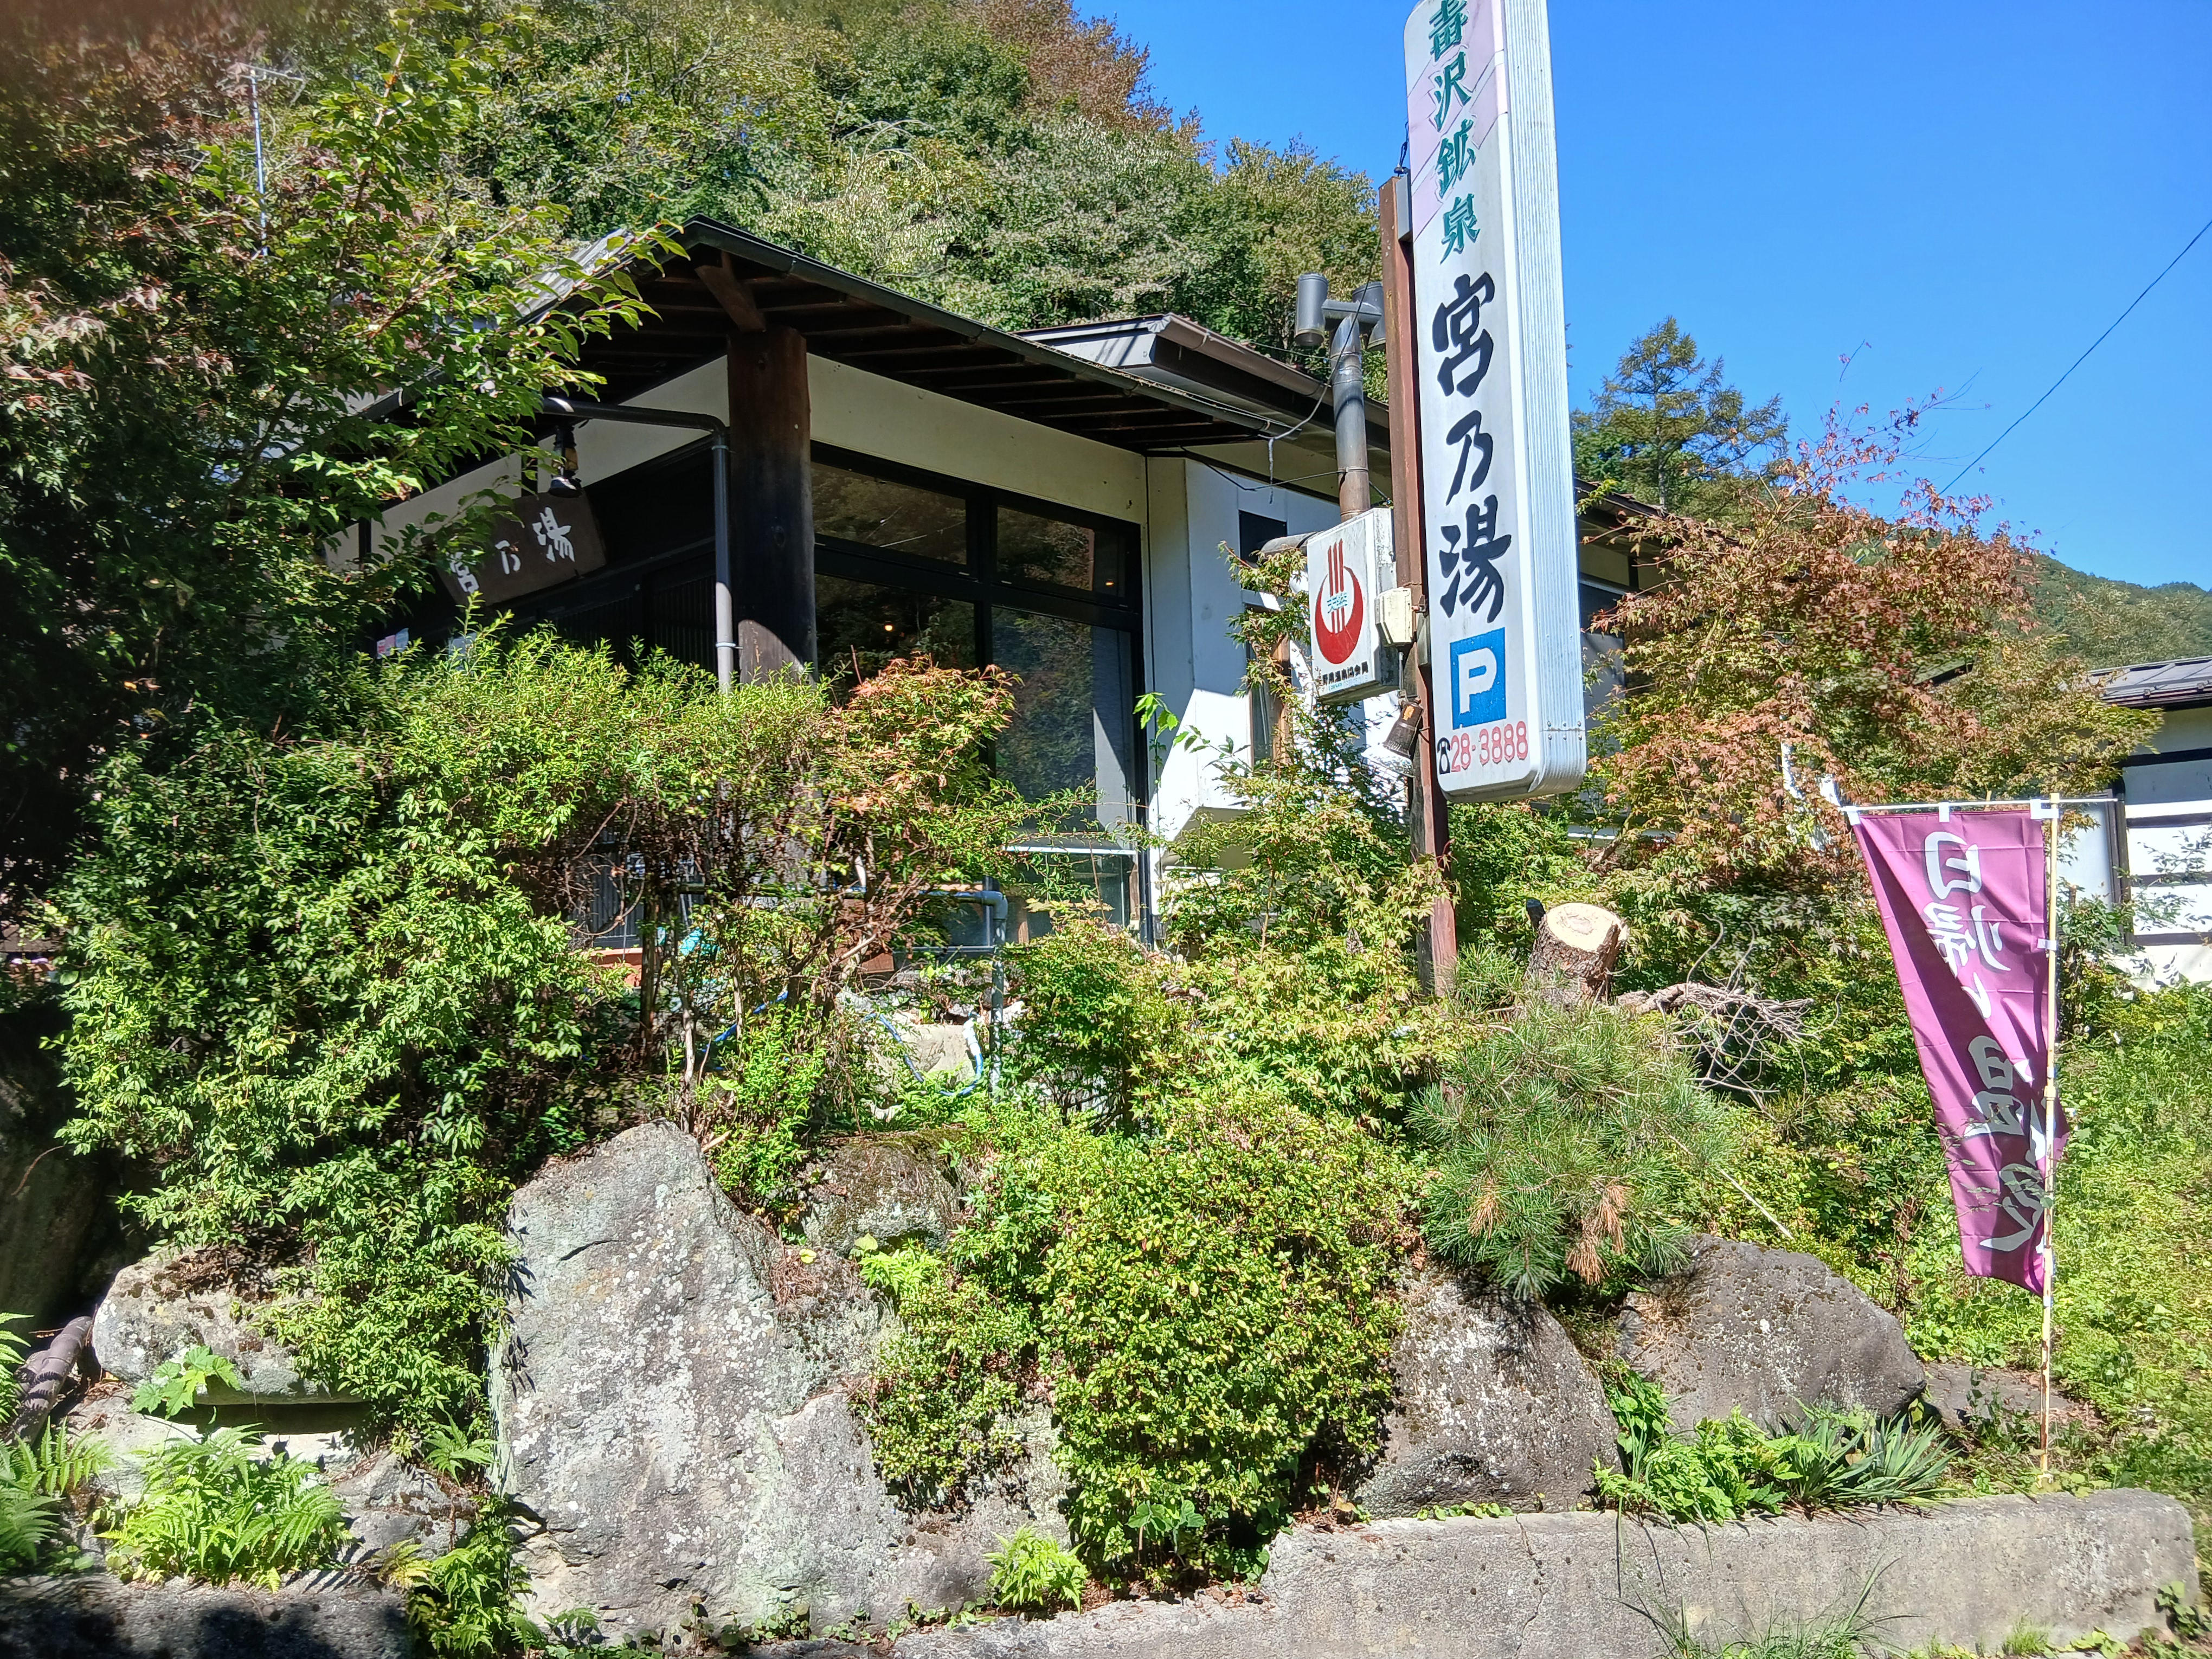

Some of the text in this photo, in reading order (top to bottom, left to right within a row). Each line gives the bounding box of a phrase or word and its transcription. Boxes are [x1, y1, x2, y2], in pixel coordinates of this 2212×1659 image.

[1428, 0, 1480, 263] 毒沢鉱泉
[1432, 271, 1512, 623] 宮乃湯
[1315, 661, 1369, 687] 野県温泉協会員
[1457, 646, 1497, 716] P
